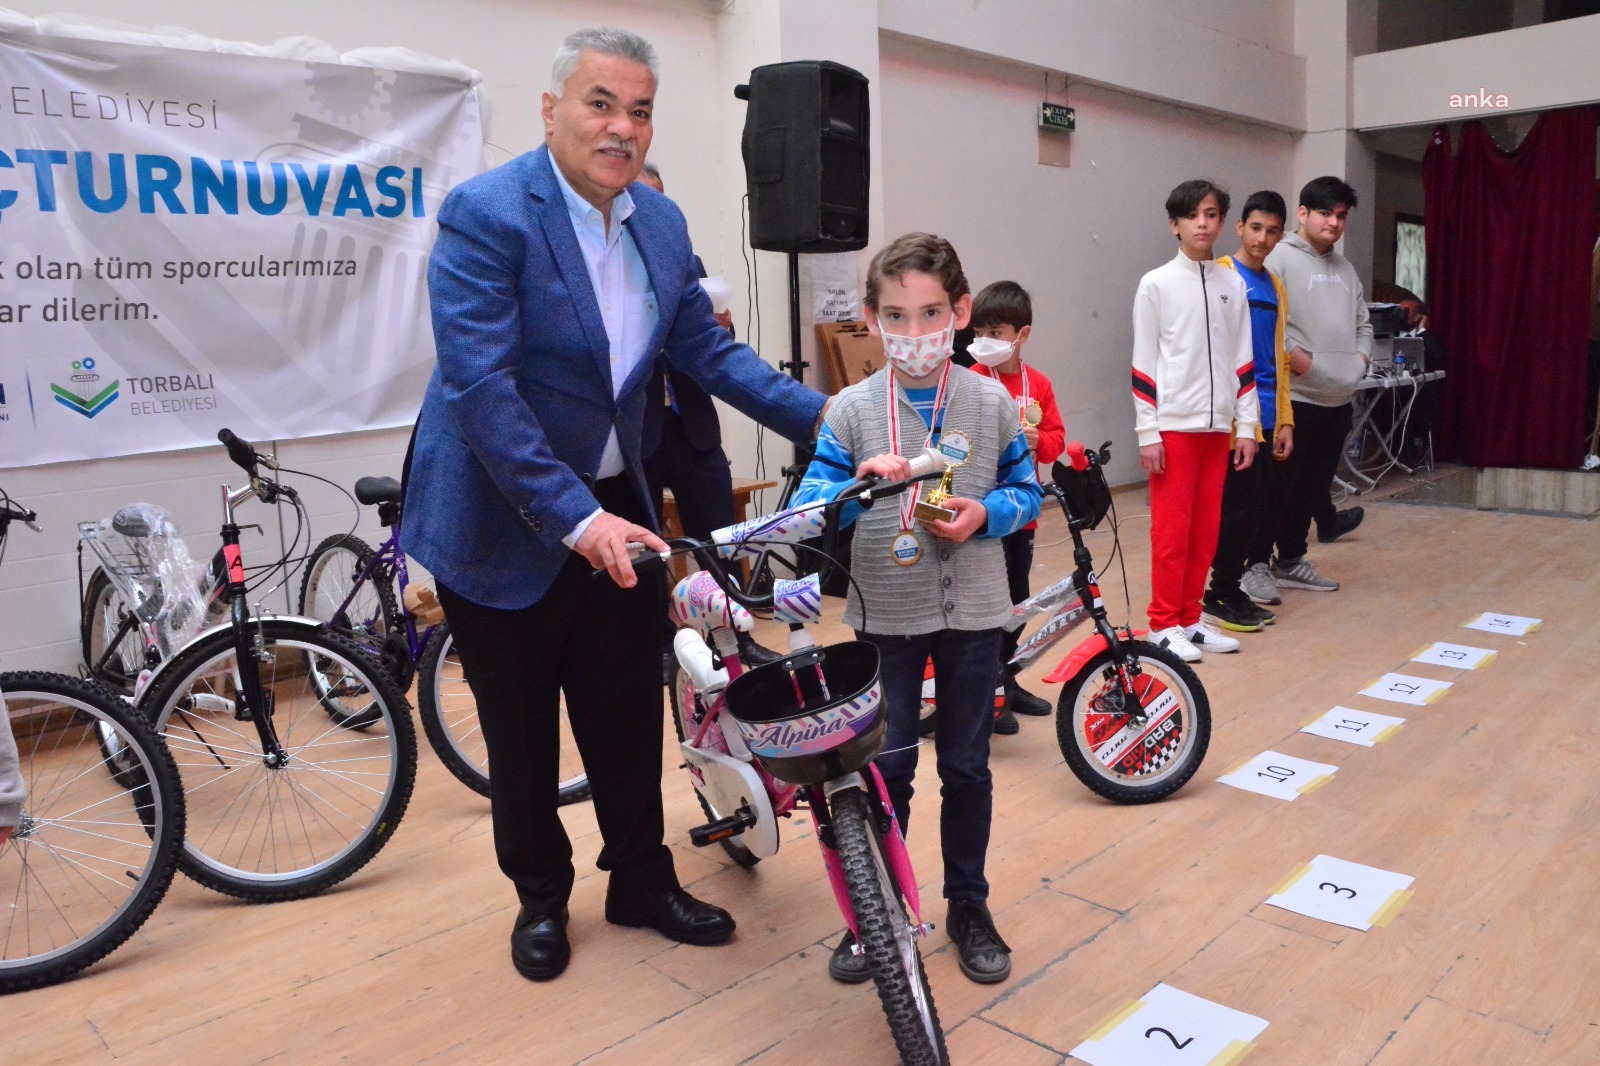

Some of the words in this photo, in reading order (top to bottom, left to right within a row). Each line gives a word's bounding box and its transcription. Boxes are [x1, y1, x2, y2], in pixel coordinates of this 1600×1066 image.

[0, 86, 217, 129] ELEDİYESİ
[1050, 107, 1067, 116] EXIT
[16, 255, 82, 279] olan
[94, 257, 152, 279] tüm
[163, 255, 357, 284] sporcularımıza
[42, 297, 158, 322] dilerim.
[126, 373, 214, 395] TORBALI
[130, 397, 217, 416] BELEDİYESİ
[230, 555, 243, 569] A
[1488, 618, 1515, 628] 14
[1439, 650, 1467, 660] 13
[1389, 682, 1420, 695] 12
[755, 717, 847, 749] Alpina
[1144, 718, 1176, 748] BAD
[1334, 719, 1369, 733] 11
[1257, 765, 1296, 783] 10
[1318, 882, 1357, 899] 3
[1144, 1027, 1194, 1050] 2
